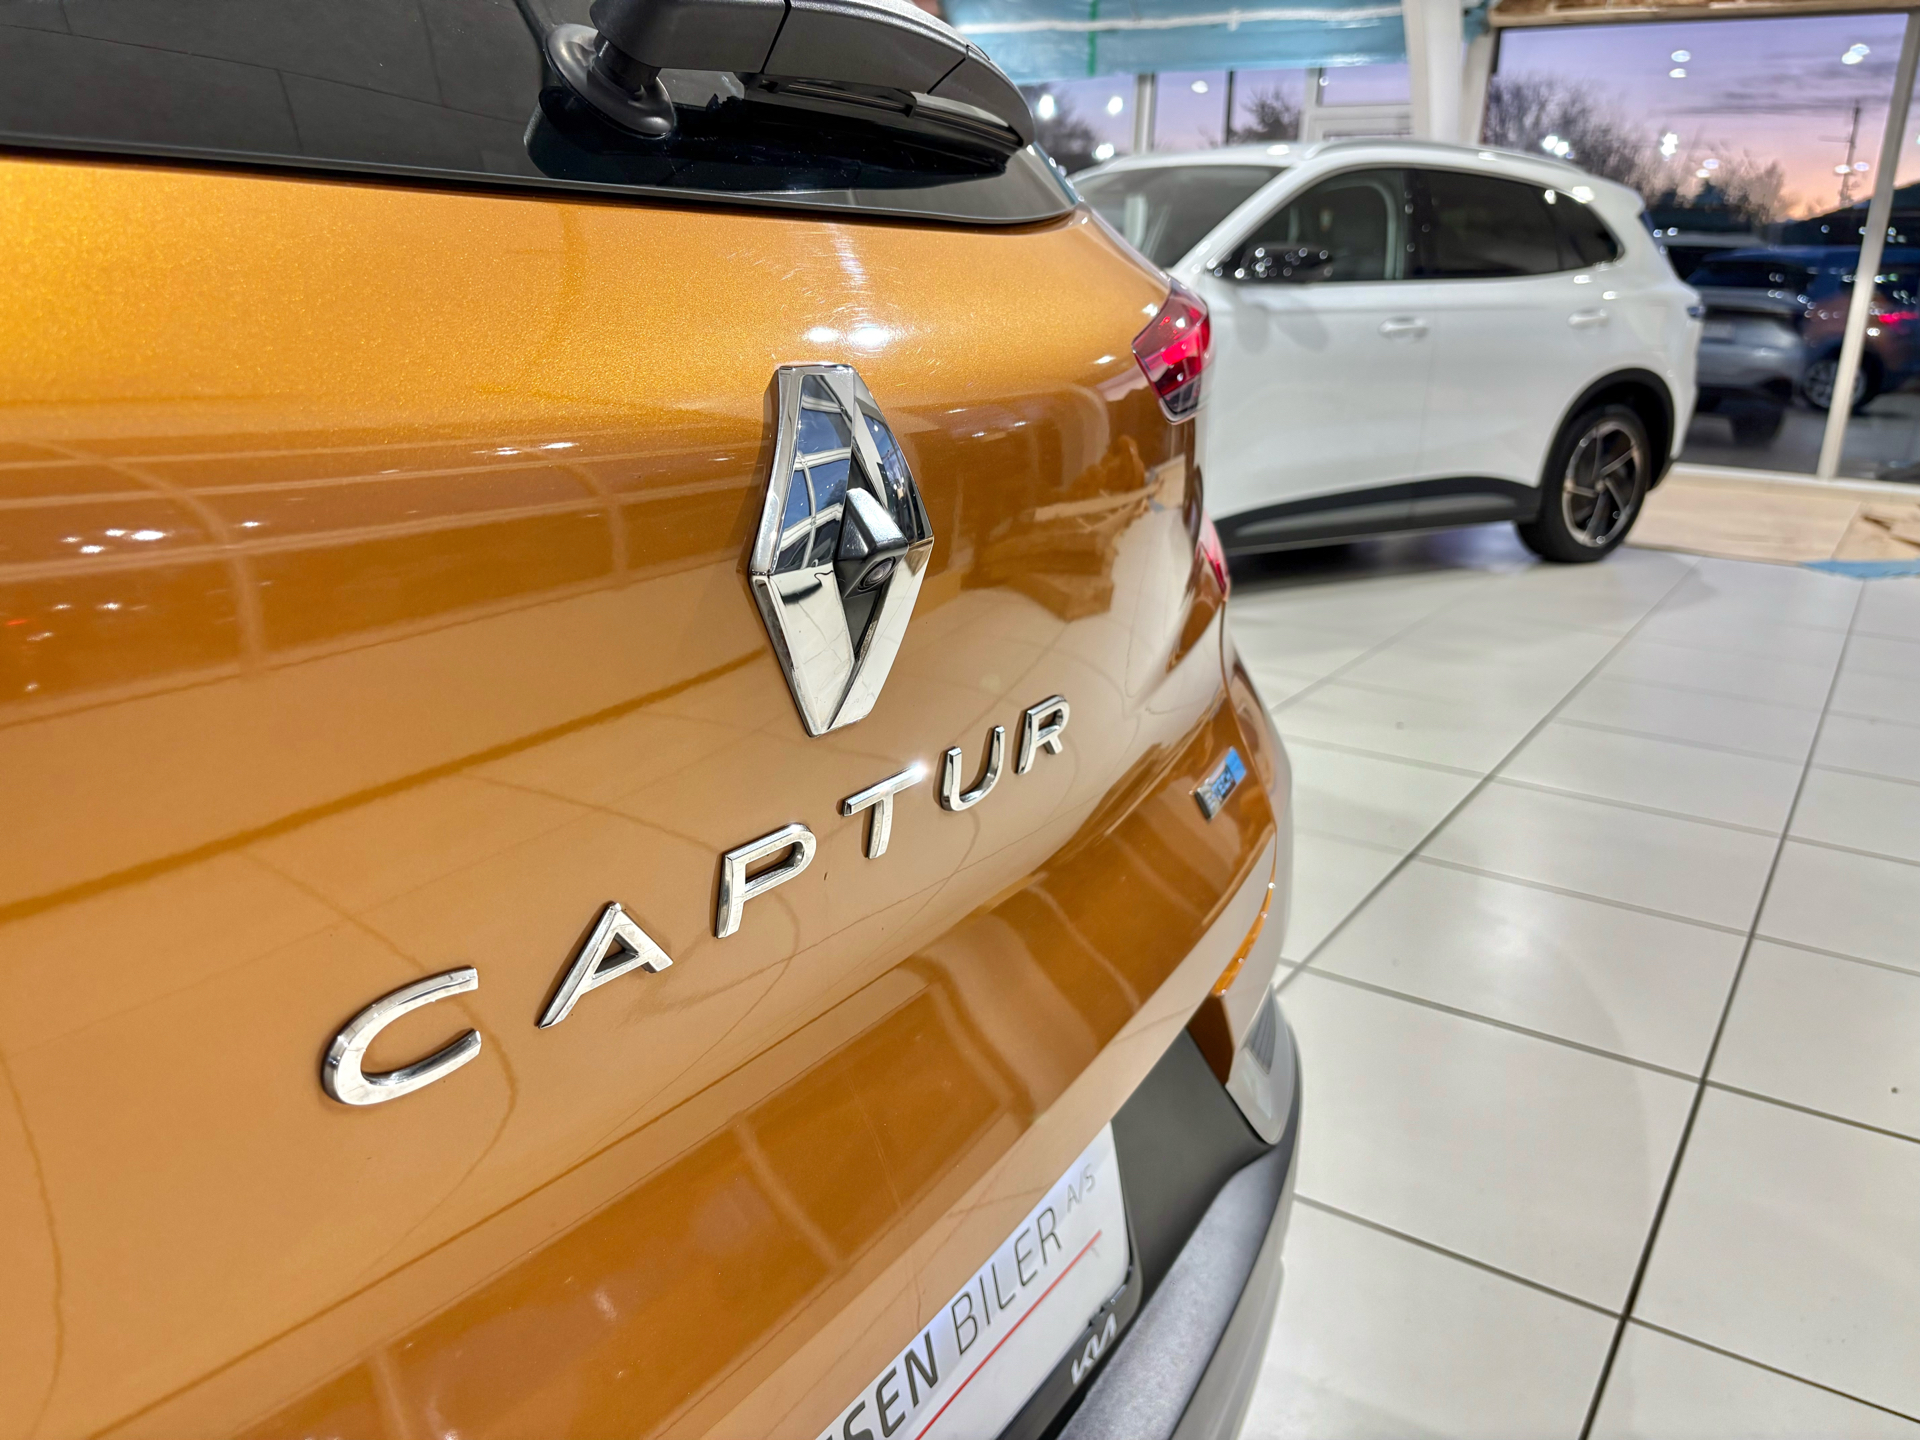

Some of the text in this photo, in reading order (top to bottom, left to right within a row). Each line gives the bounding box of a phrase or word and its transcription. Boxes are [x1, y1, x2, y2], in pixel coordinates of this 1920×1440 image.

[322, 694, 1070, 1106] CAPTUR
[826, 1163, 1096, 1440] SEN BILER A/S
